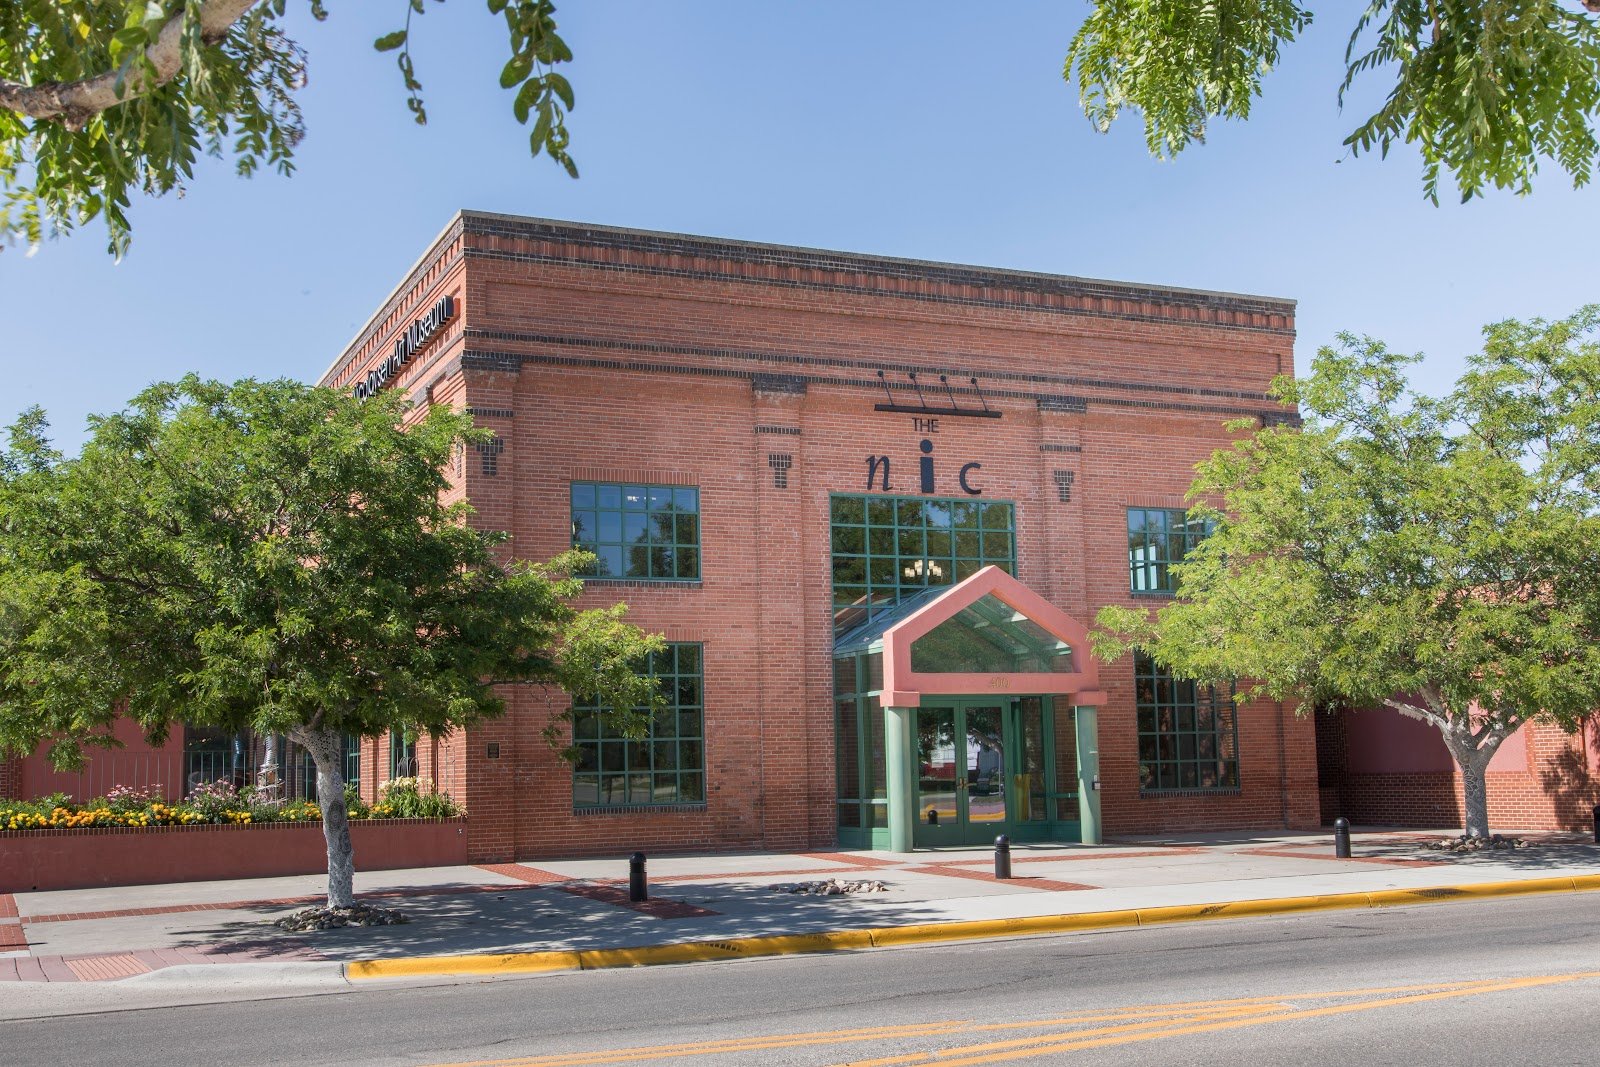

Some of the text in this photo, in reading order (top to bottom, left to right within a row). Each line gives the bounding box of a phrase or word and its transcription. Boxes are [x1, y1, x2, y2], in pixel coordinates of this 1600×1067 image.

[393, 332, 407, 372] Art
[407, 295, 452, 355] Museum
[911, 417, 940, 433] THE
[865, 439, 982, 495] nic
